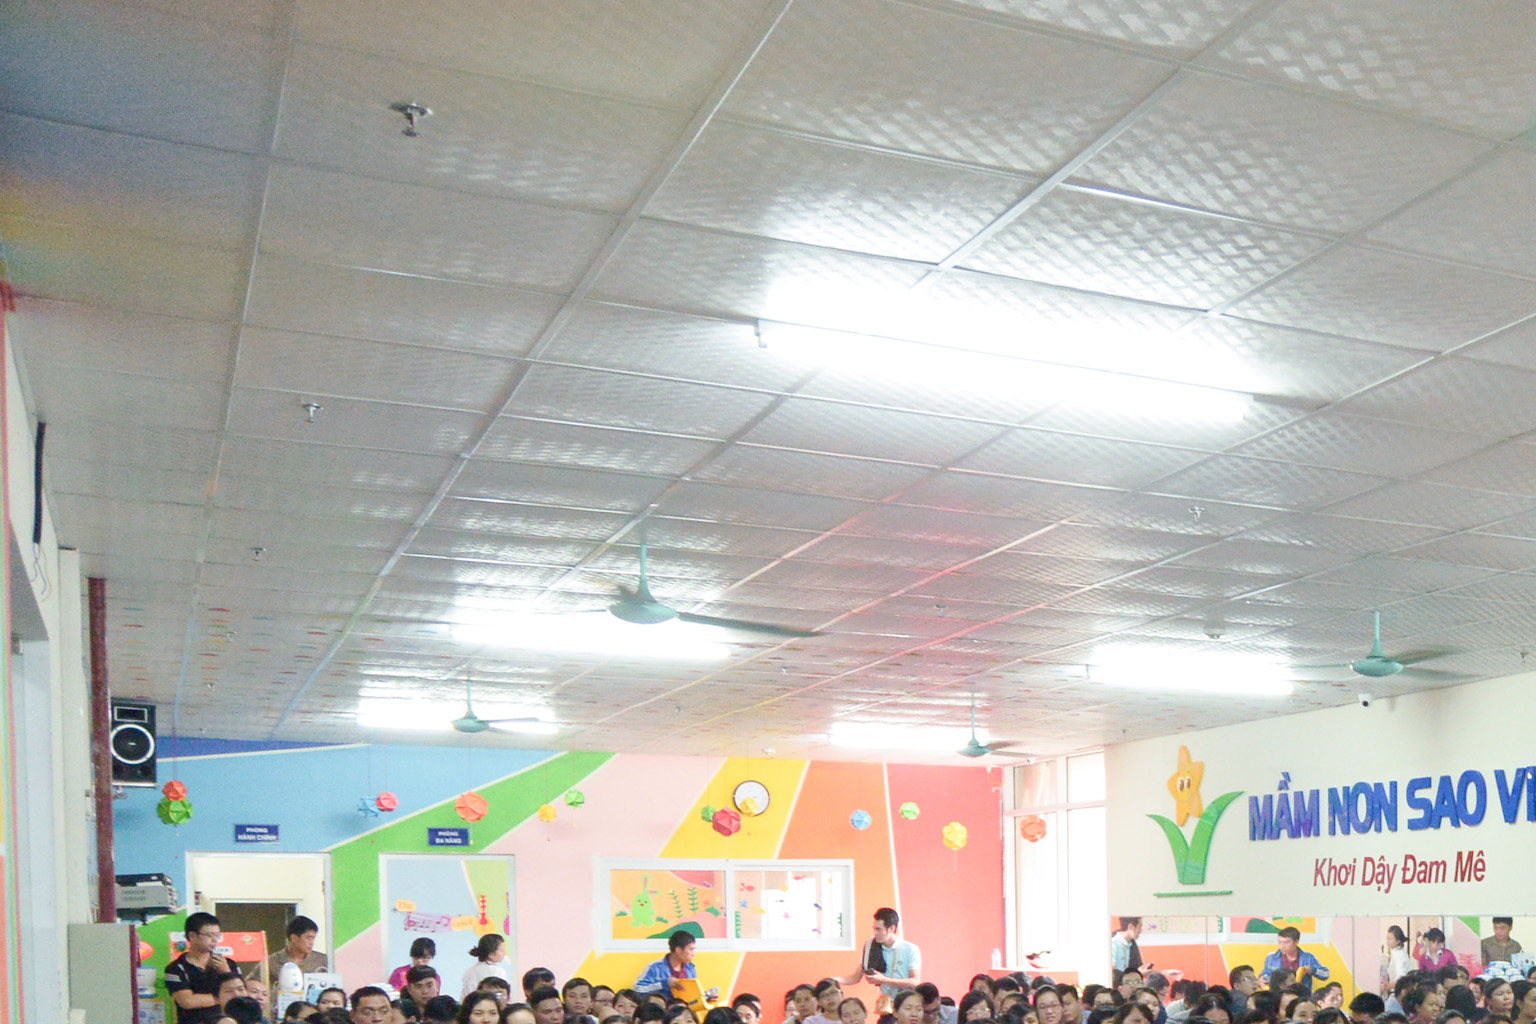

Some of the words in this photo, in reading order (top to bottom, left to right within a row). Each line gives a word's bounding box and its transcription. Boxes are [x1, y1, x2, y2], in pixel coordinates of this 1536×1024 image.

[1249, 771, 1320, 841] MẦM
[1328, 780, 1398, 836] NON
[1406, 770, 1487, 830] SAO
[1313, 857, 1357, 887] Khơi
[1361, 855, 1397, 894] Dậy
[1401, 853, 1447, 884] Đam
[1454, 850, 1486, 883] Mê
